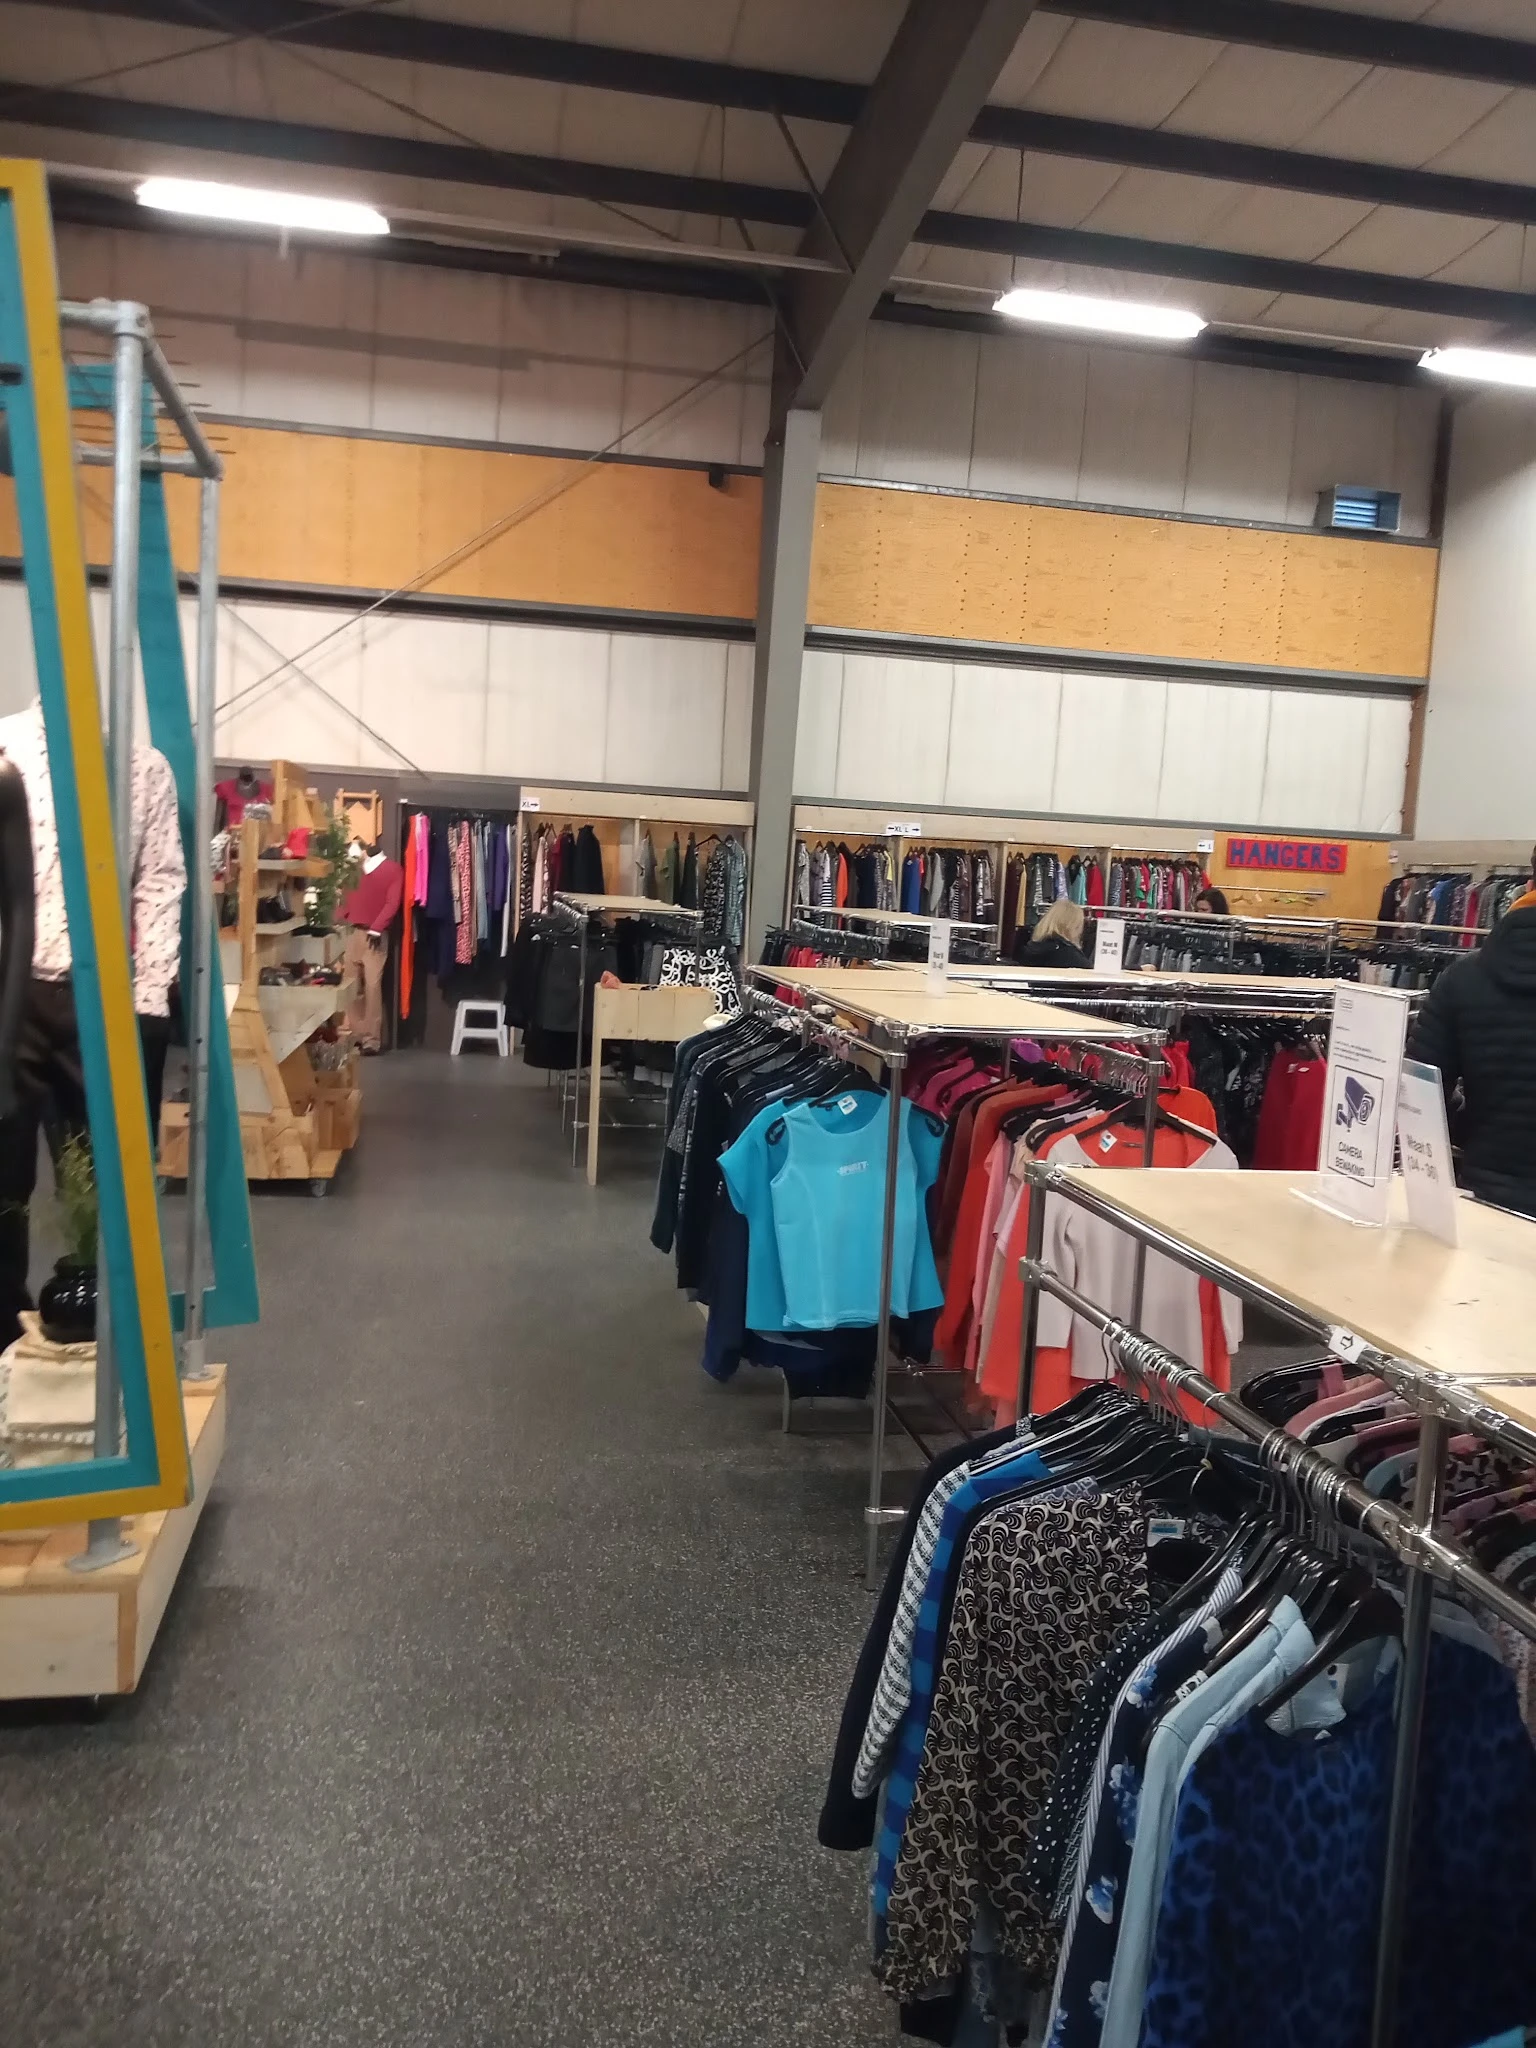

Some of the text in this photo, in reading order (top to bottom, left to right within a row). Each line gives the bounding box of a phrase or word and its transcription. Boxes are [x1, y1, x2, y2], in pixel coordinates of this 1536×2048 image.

[1230, 841, 1341, 869] HANGERS
[1338, 1141, 1363, 1160] CAMERA
[1335, 1156, 1365, 1177] BEWAKING
